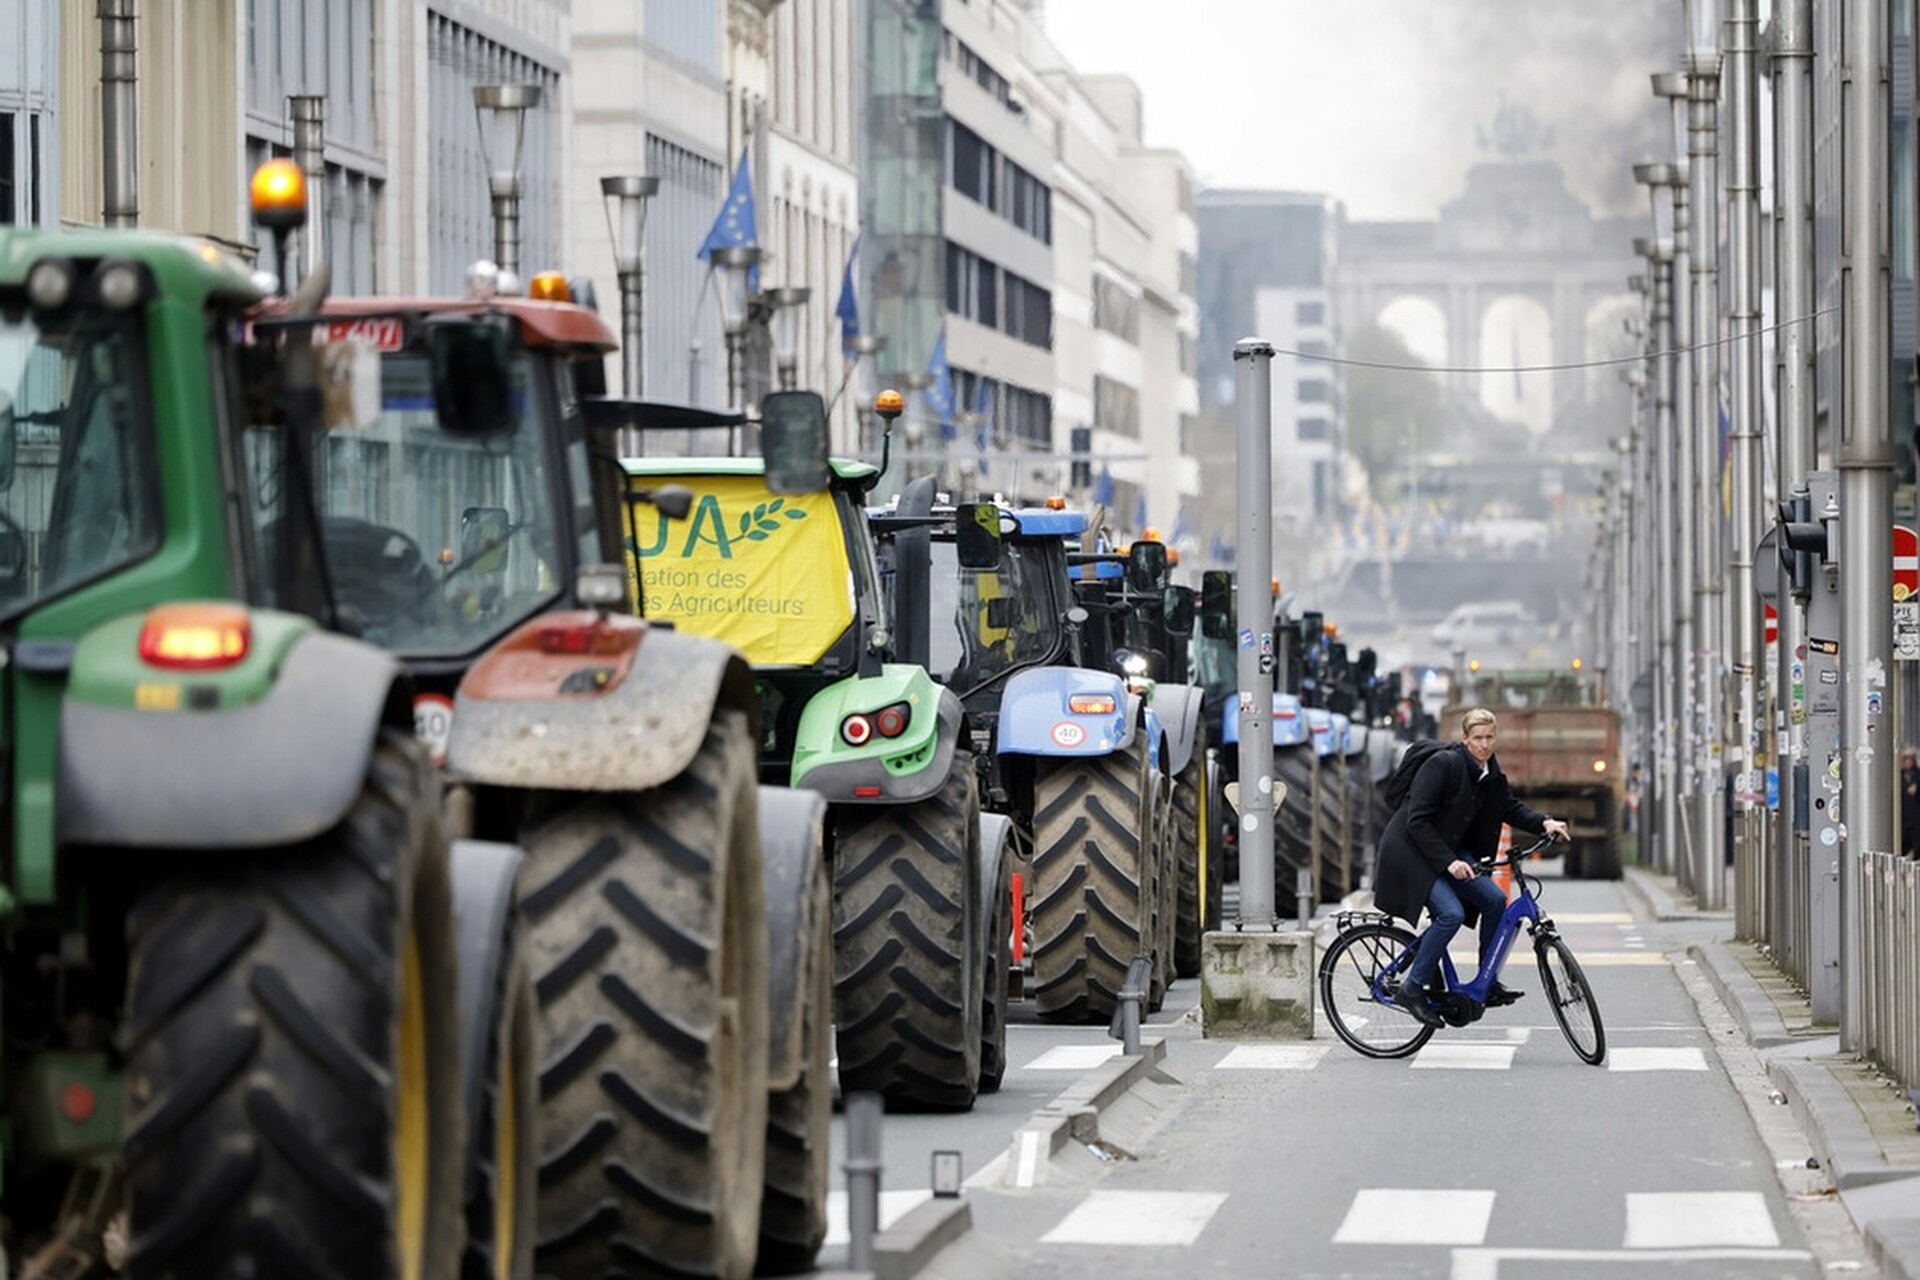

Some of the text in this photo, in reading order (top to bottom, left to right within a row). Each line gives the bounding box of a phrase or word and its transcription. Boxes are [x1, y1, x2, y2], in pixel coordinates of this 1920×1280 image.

[706, 569, 747, 588] des
[668, 592, 804, 617] Agriculteurs
[1059, 728, 1078, 738] 40
